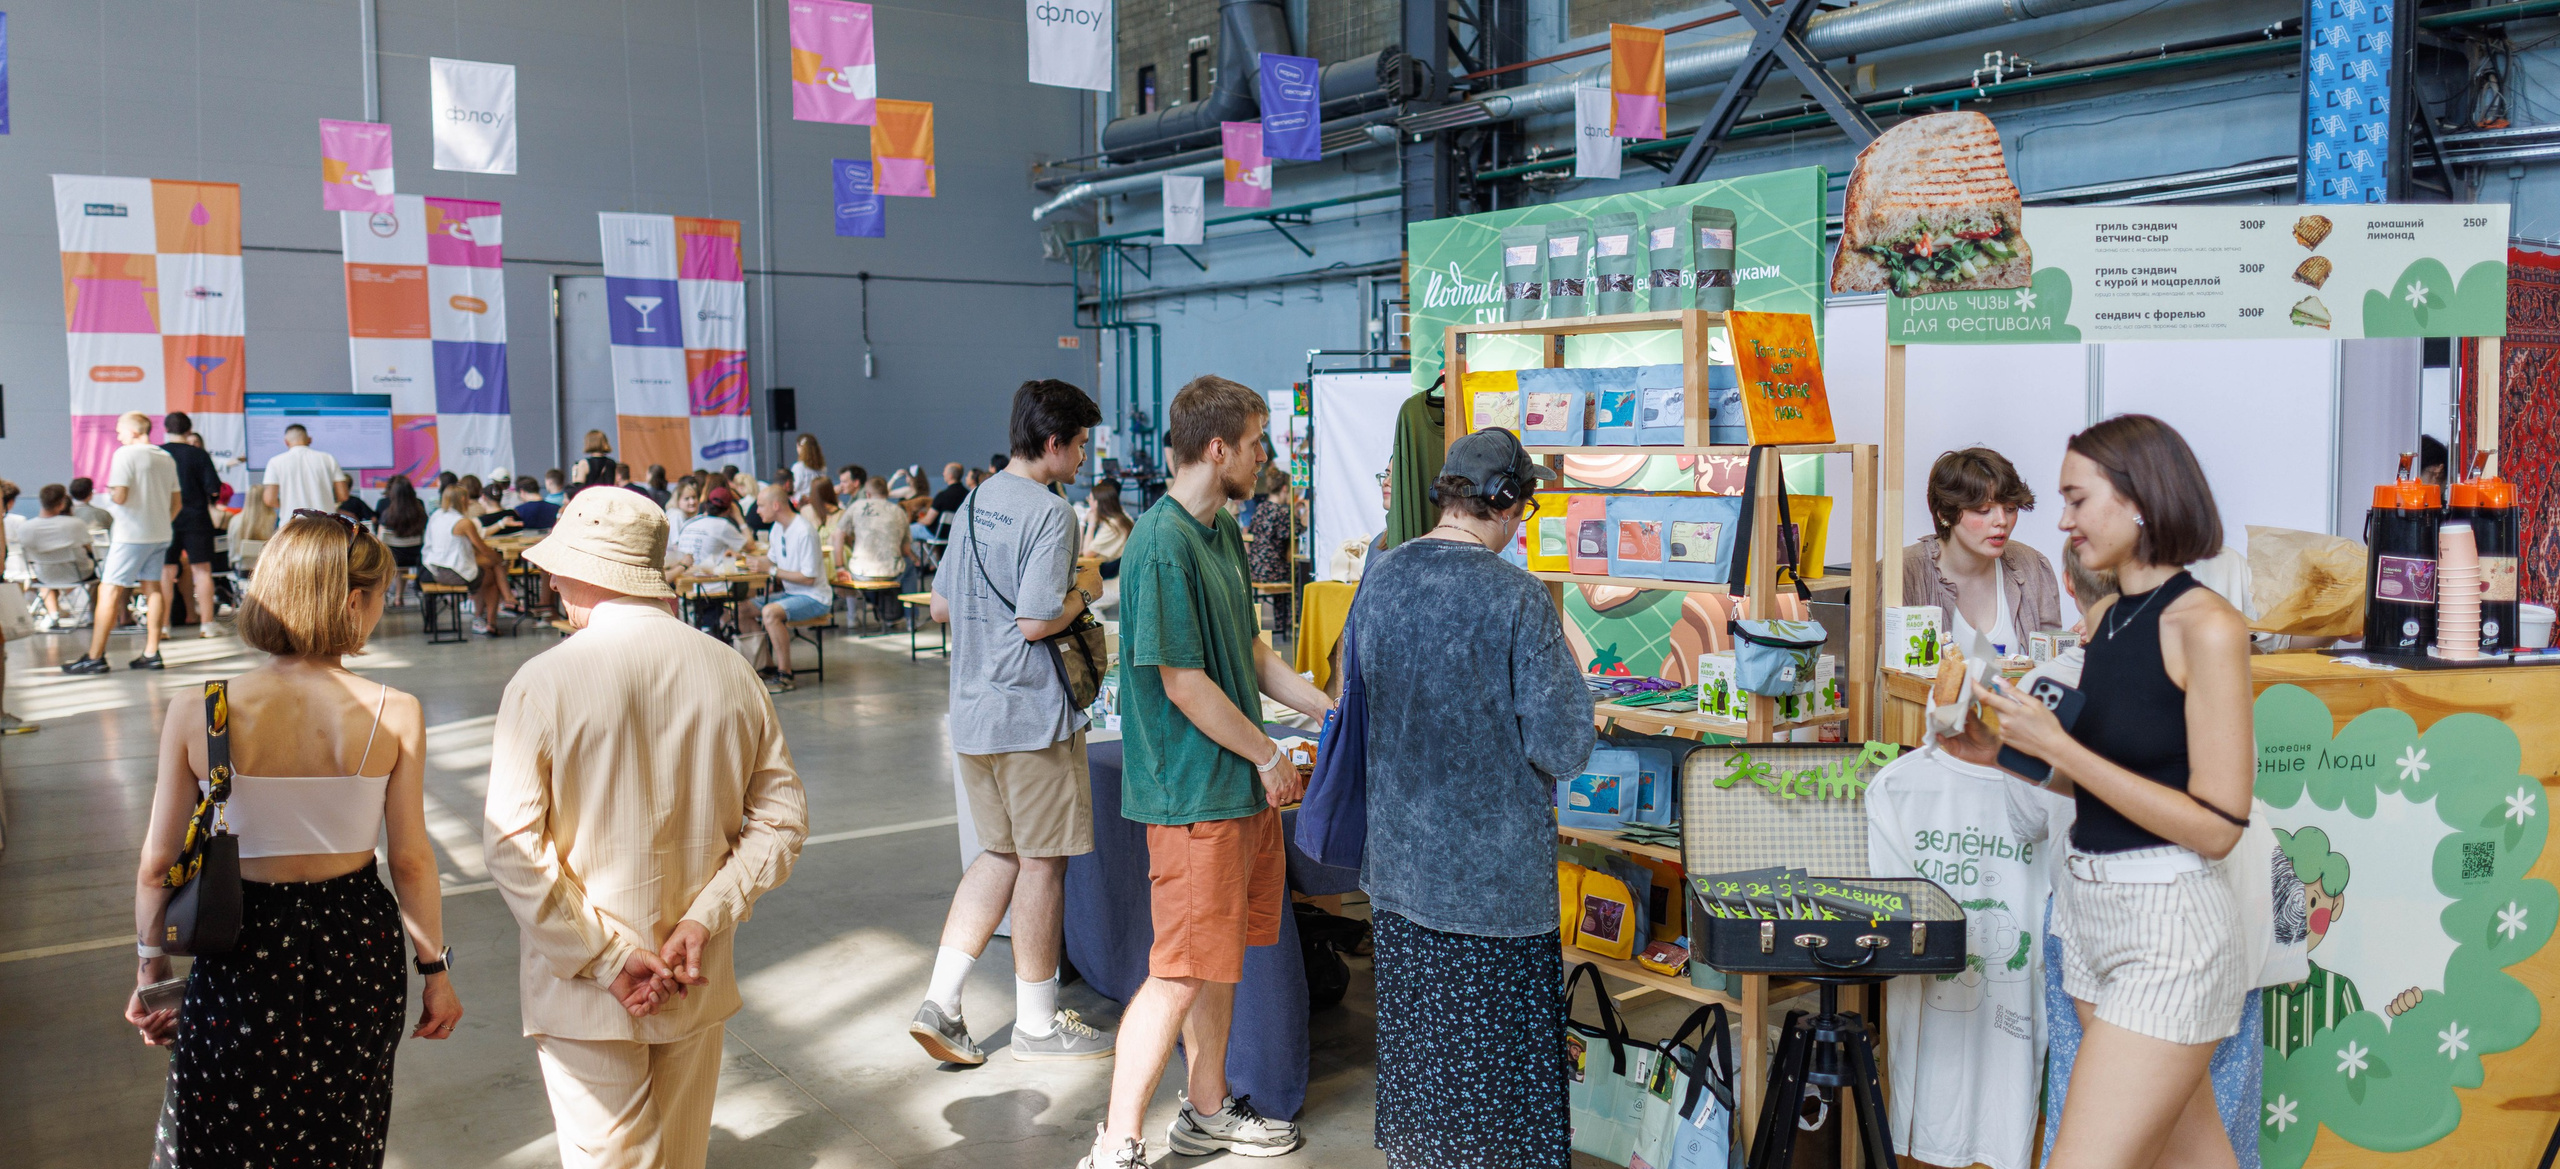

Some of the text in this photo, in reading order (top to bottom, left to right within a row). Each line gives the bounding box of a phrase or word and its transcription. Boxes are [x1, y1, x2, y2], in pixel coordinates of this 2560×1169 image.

[1036, 0, 1102, 32] флоу
[445, 106, 504, 128] флоу
[1584, 124, 1611, 140] фло
[2095, 222, 2178, 233] гриль сэндвич
[2366, 218, 2425, 230] домашний
[2095, 233, 2169, 244] ветчина-сыр
[2366, 231, 2416, 241] лимонад
[2095, 266, 2177, 277] гриль сэндвич
[2095, 279, 2101, 287] с
[2104, 277, 2138, 289] курой
[2151, 276, 2221, 288] моцареллой
[1966, 295, 2009, 310] чизы
[2095, 311, 2141, 321] сендвич
[2153, 309, 2206, 321] форелью
[1902, 316, 2051, 336] для фестиваля
[1750, 339, 1776, 358] Тот
[1756, 381, 1776, 399] ТЕ
[992, 511, 1014, 526] PLANS
[2264, 744, 2312, 753] кофейня
[2318, 747, 2376, 771] Люди
[1914, 826, 2033, 865] зелёные
[1914, 857, 1980, 886] клаб
